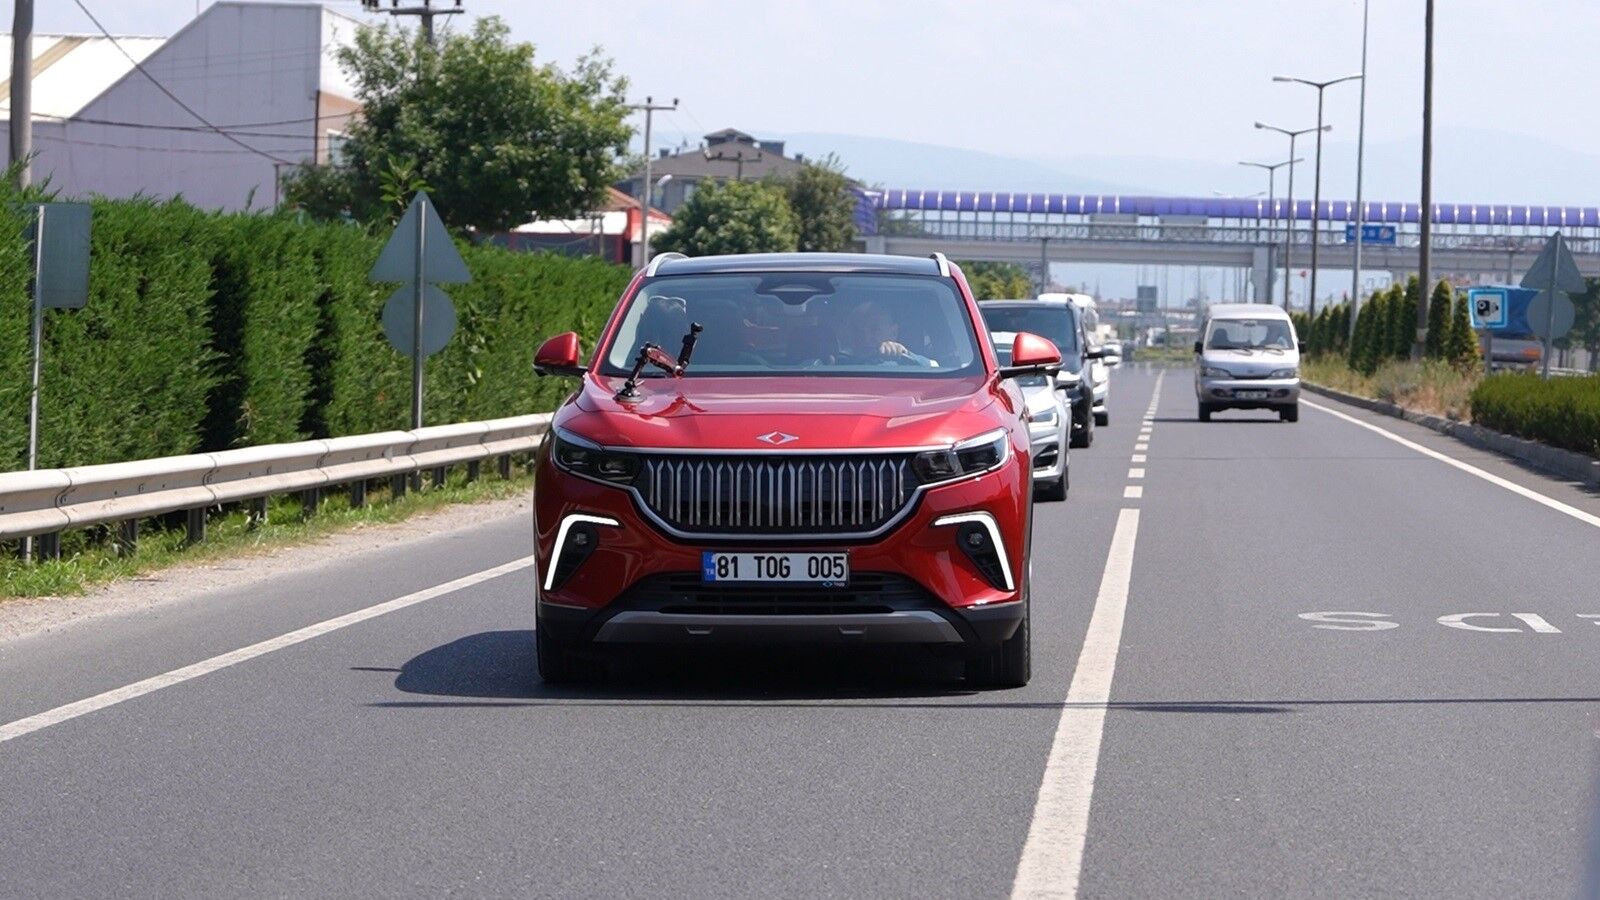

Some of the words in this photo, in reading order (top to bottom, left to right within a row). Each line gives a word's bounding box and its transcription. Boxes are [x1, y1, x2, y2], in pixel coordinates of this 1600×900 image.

[717, 556, 738, 578] 81
[753, 556, 790, 578] TOG
[808, 556, 845, 578] 005
